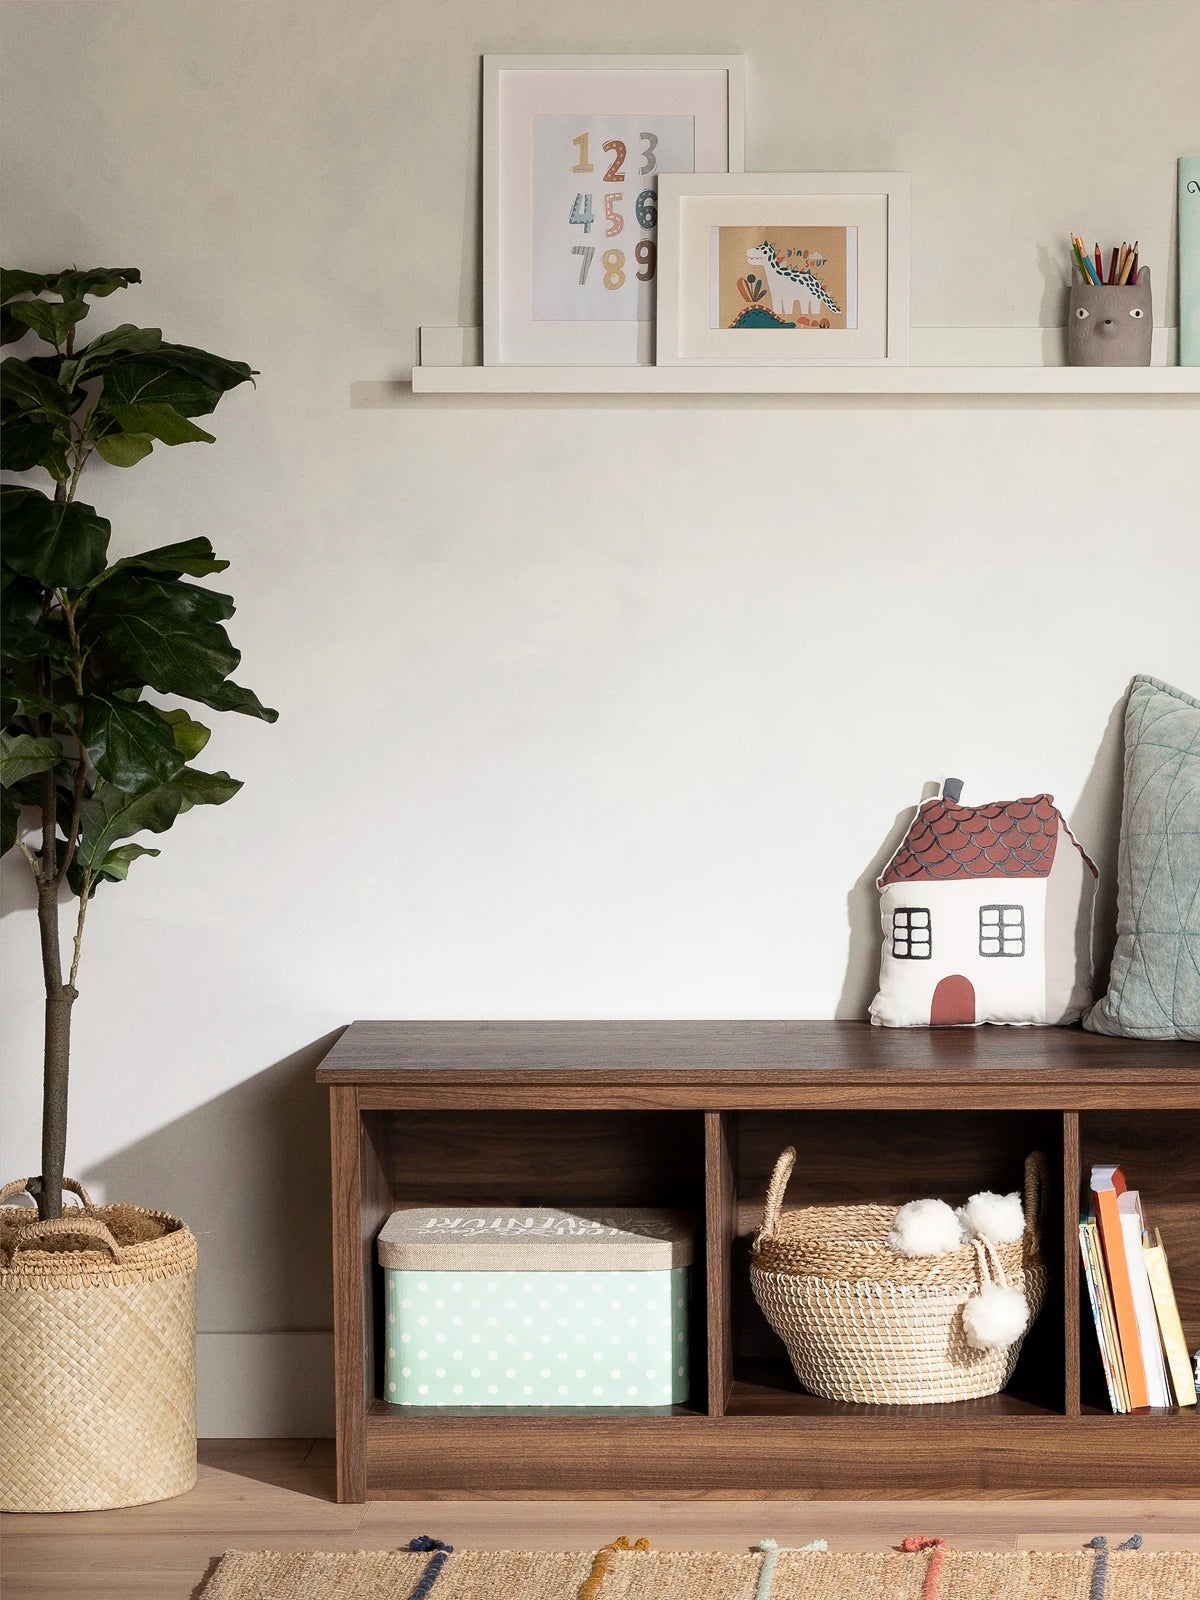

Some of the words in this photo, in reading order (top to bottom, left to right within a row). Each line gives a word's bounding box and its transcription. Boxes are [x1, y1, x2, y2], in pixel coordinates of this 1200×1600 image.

[570, 132, 595, 174] 1
[602, 140, 627, 182] 2
[638, 132, 659, 175] 3
[568, 192, 595, 234] 4
[604, 192, 624, 238] 5
[635, 189, 657, 230] 6
[570, 245, 596, 286] 7
[602, 249, 626, 291] 8
[635, 240, 657, 282] 9
